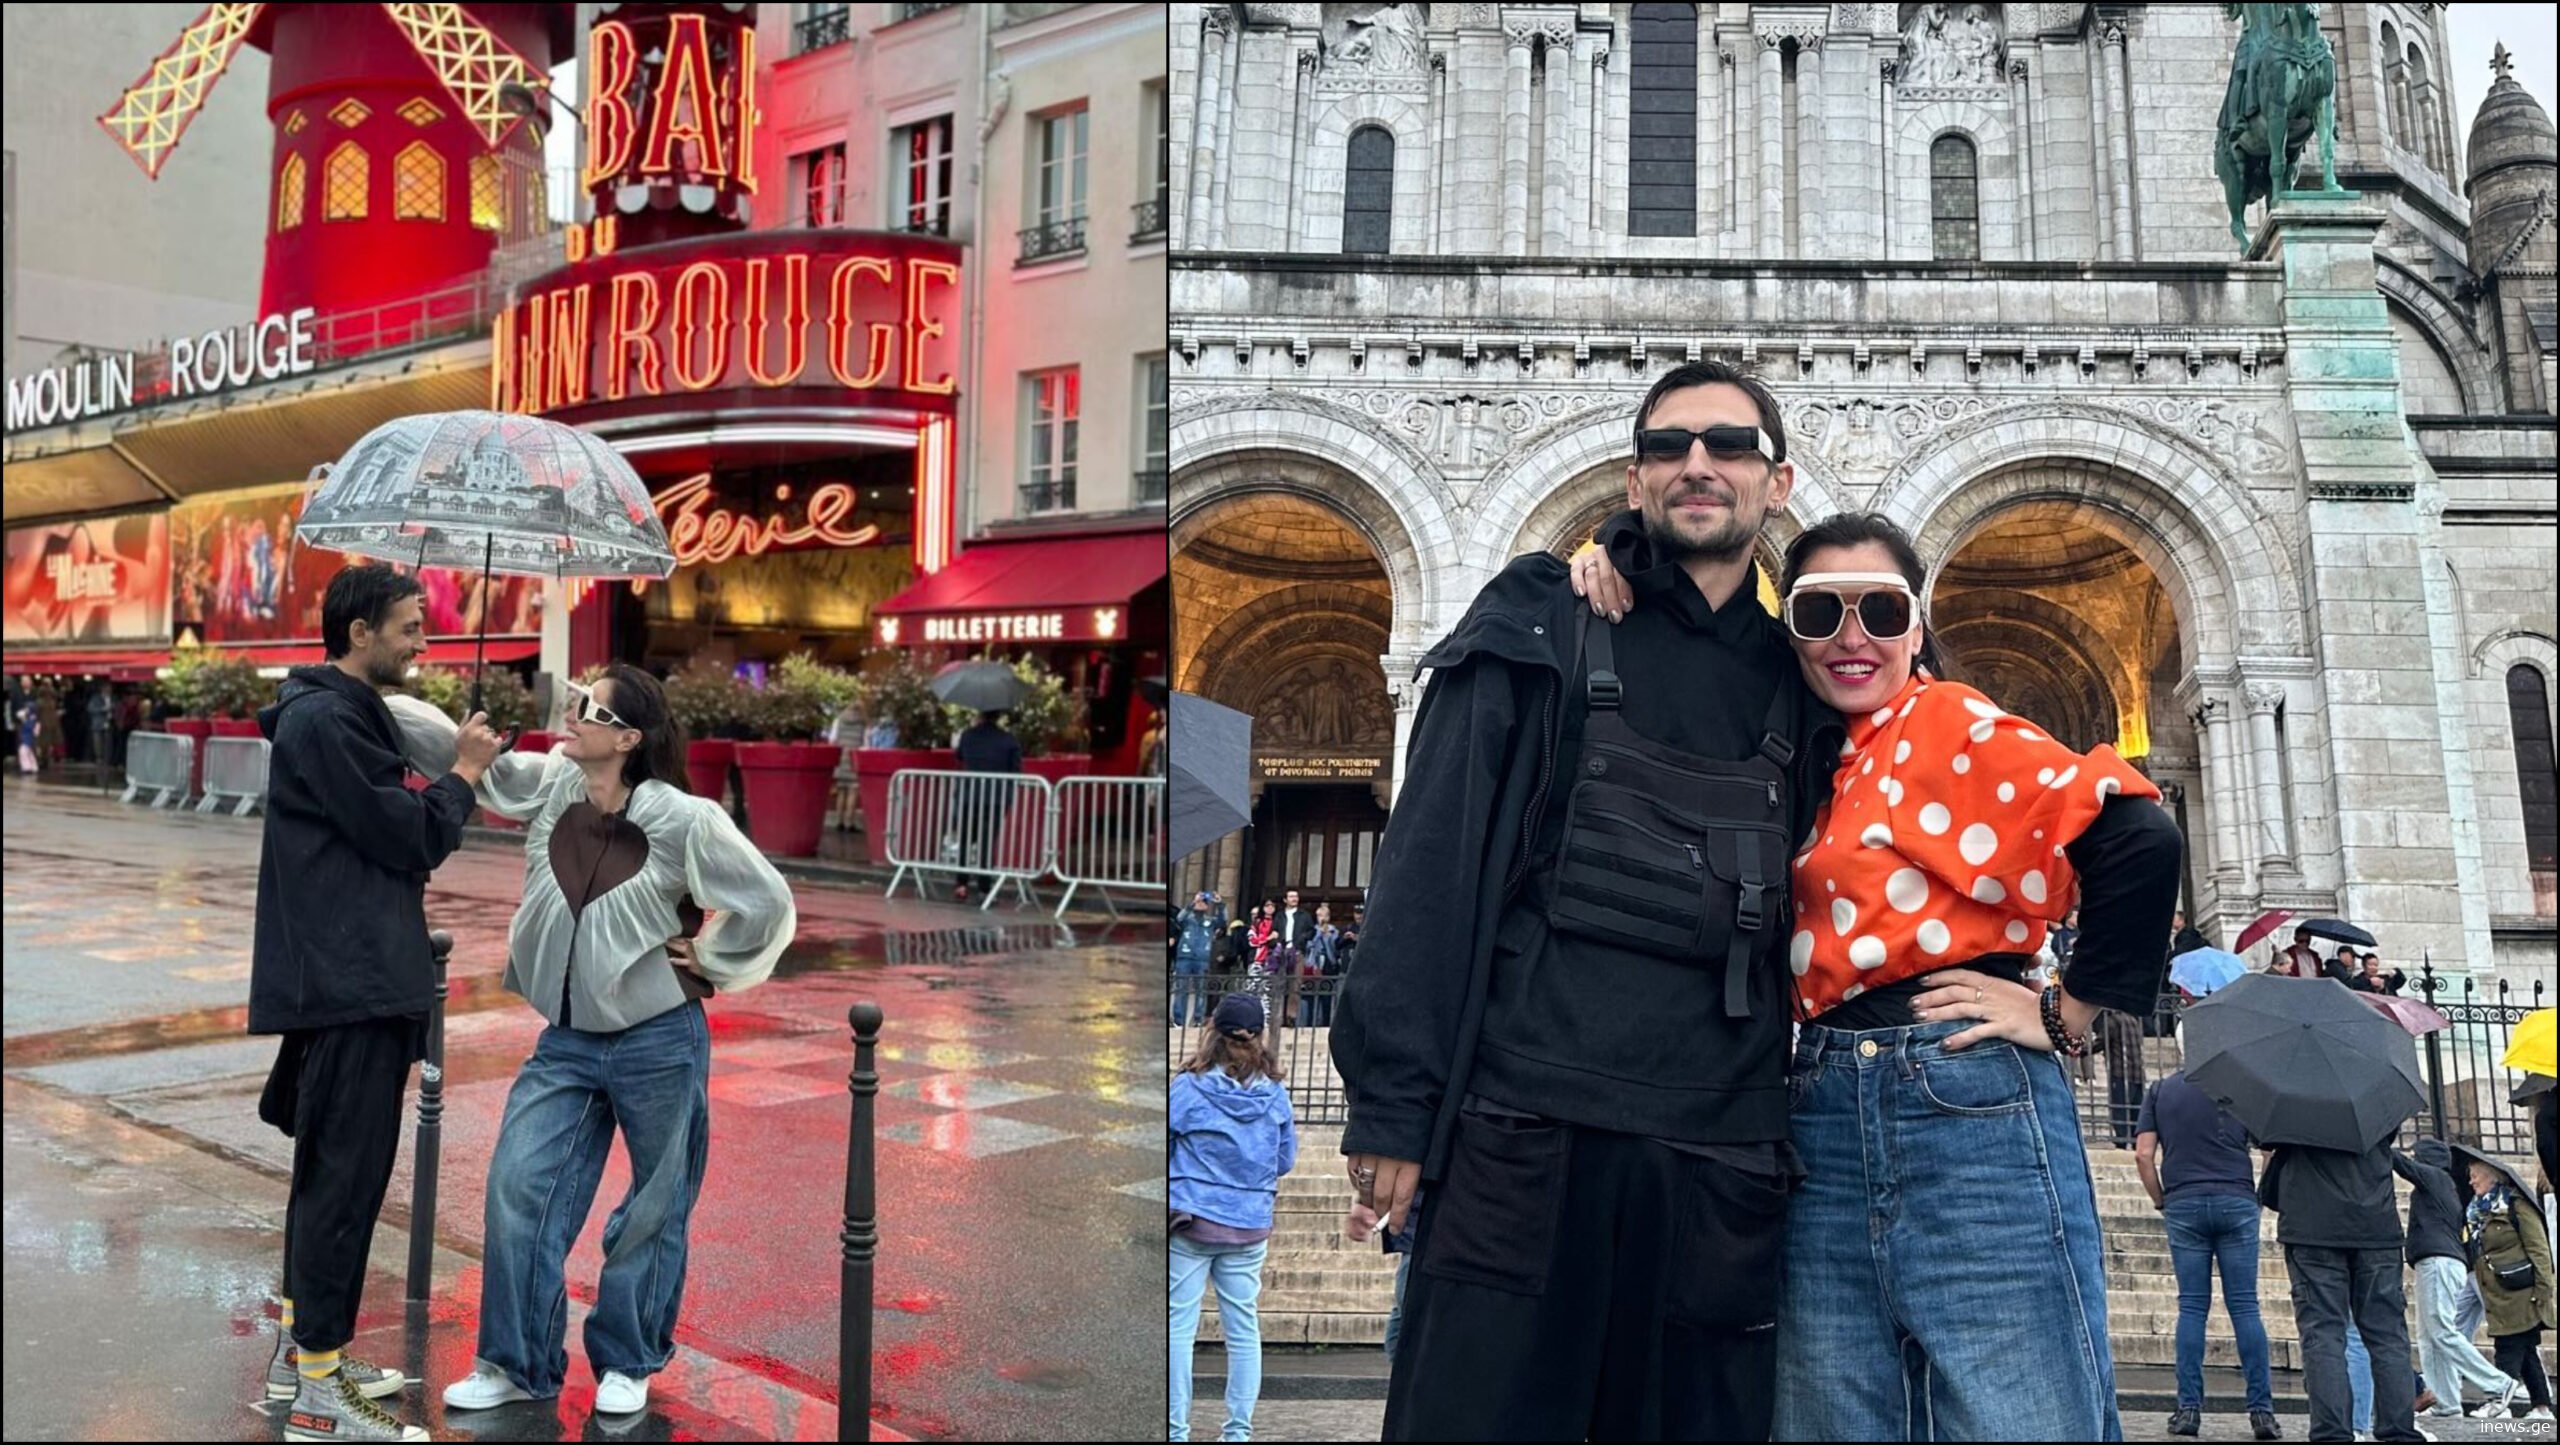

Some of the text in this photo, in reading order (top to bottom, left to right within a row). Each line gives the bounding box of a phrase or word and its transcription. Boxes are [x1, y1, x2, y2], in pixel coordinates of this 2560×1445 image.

[566, 216, 616, 262] DU
[7, 307, 315, 430] MOULIN ROUGE
[607, 255, 957, 400] ROUGE
[925, 614, 1063, 640] BILLETTERIE
